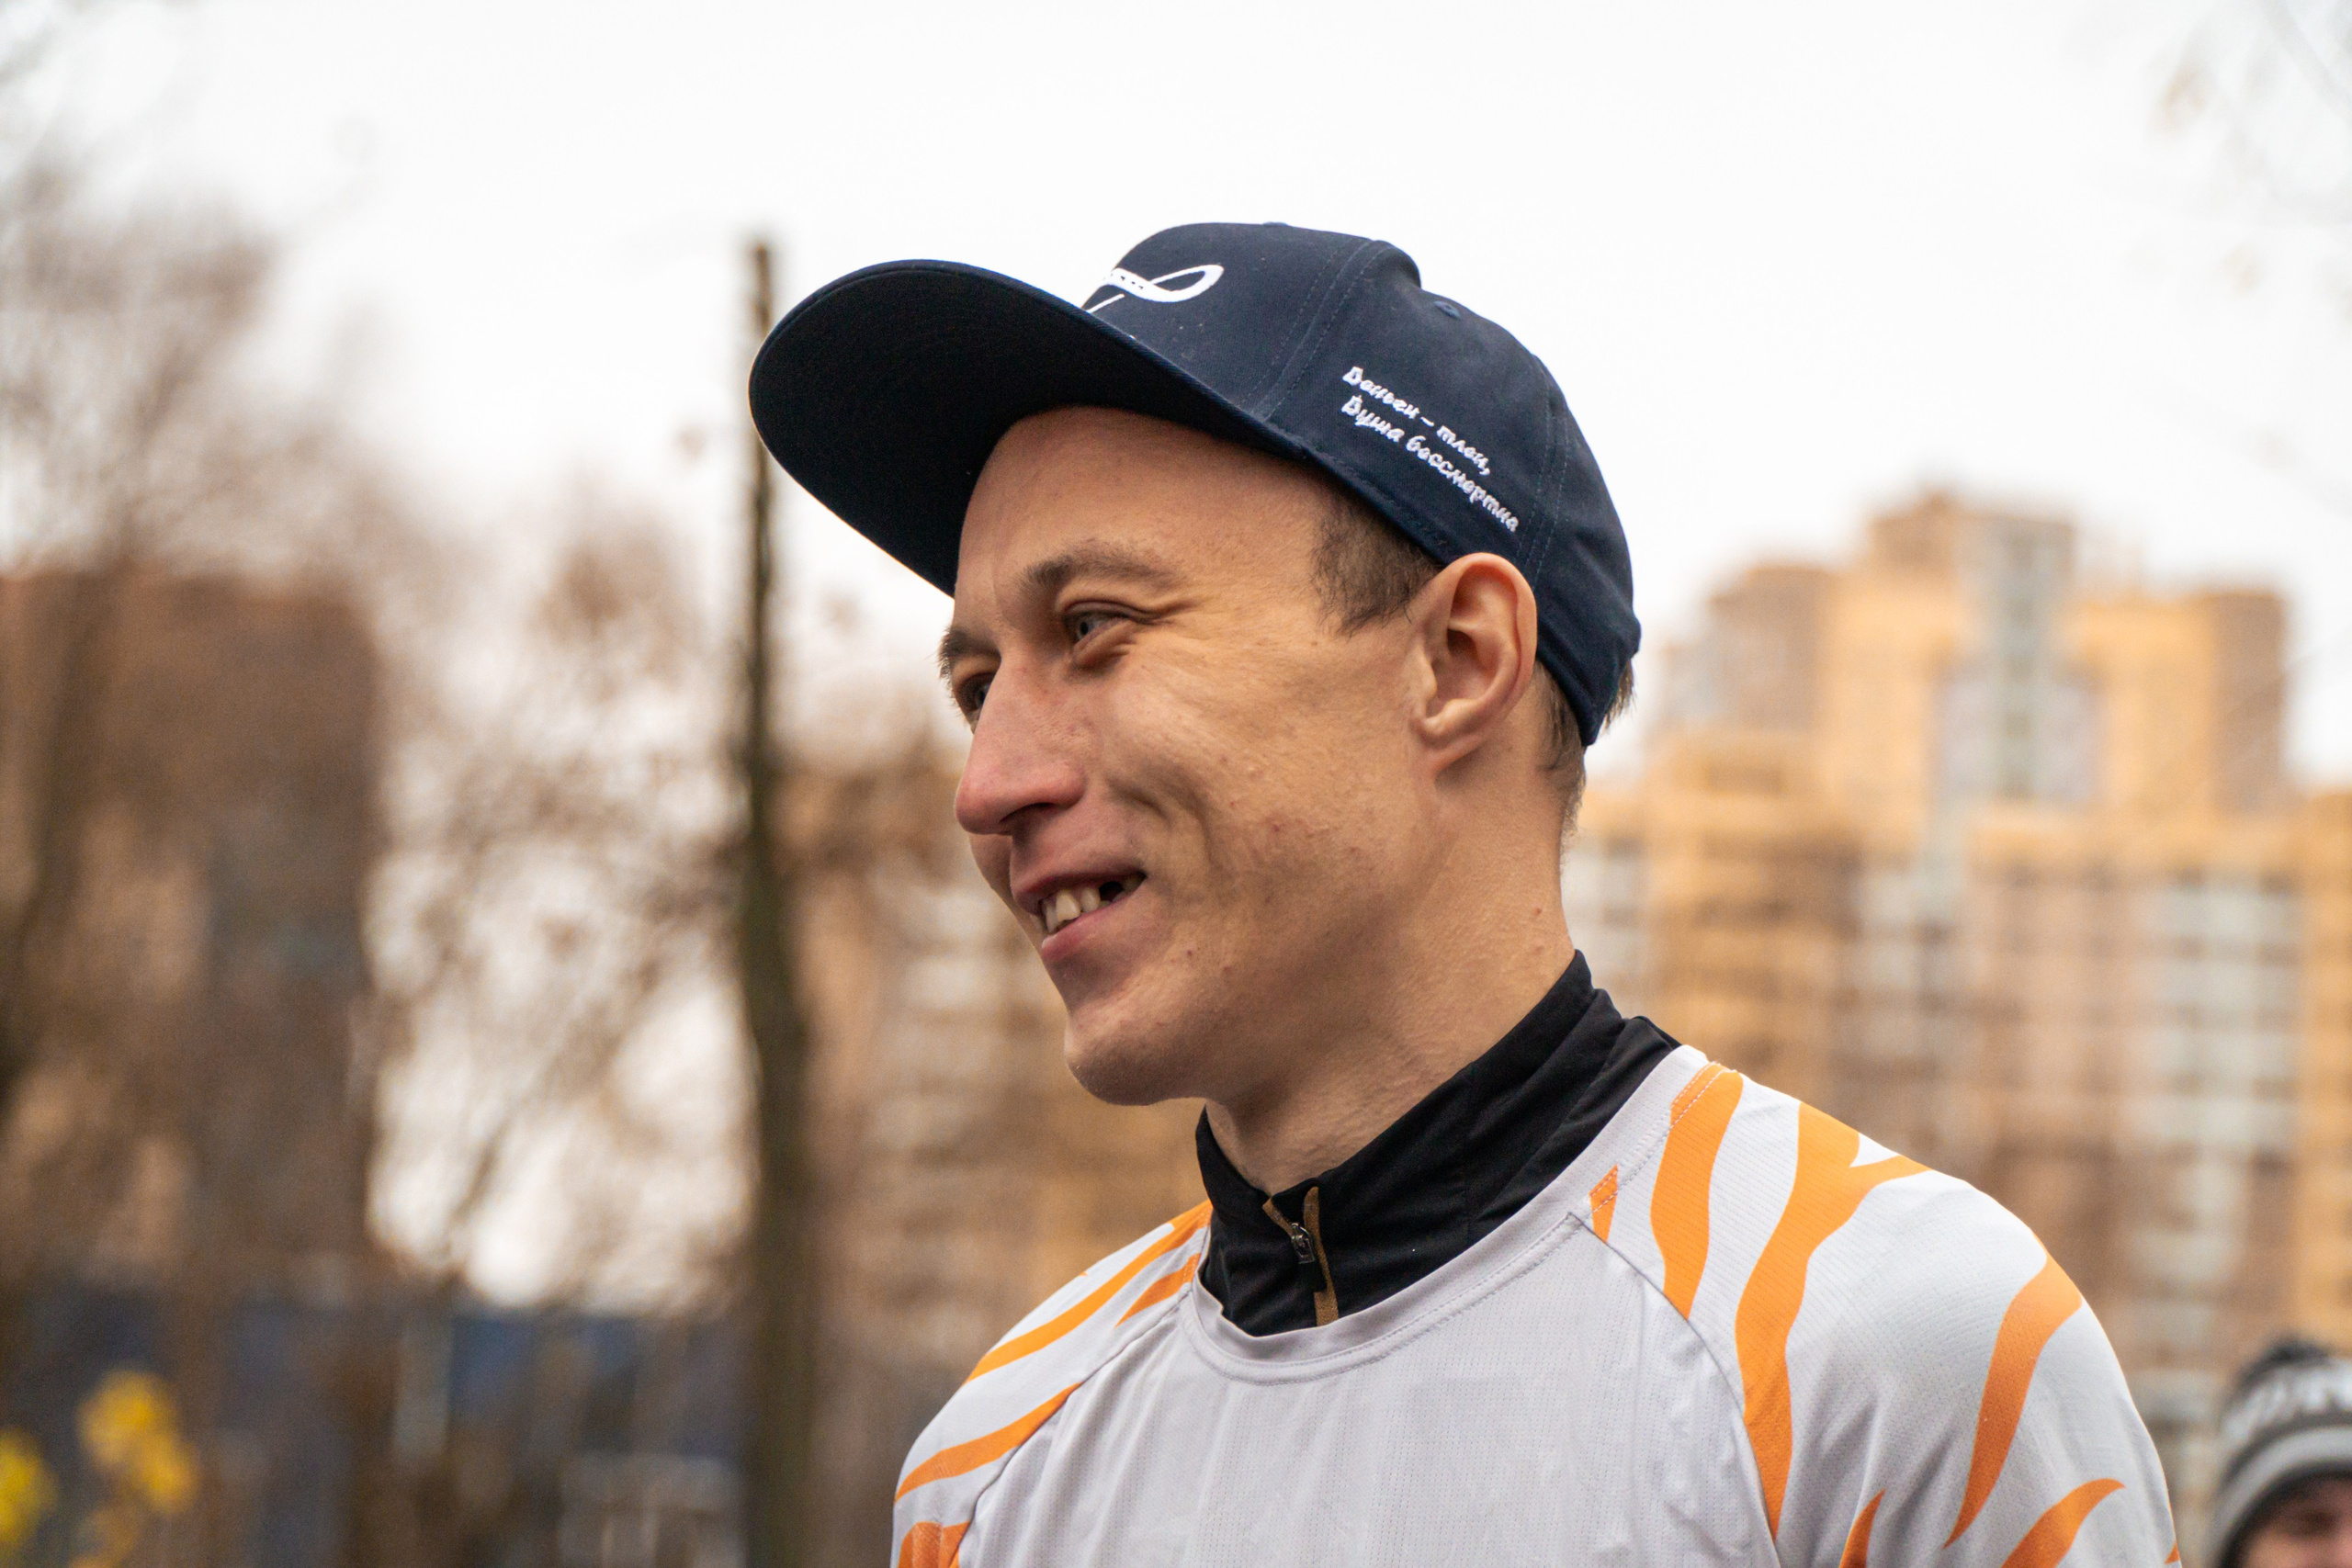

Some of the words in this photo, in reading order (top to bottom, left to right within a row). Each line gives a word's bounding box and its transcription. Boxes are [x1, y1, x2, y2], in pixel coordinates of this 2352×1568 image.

[1340, 394, 1406, 443] Душа
[1405, 434, 1519, 533] бессмертна
[1341, 366, 1420, 420] Деньги
[1436, 424, 1491, 477] тлен,
